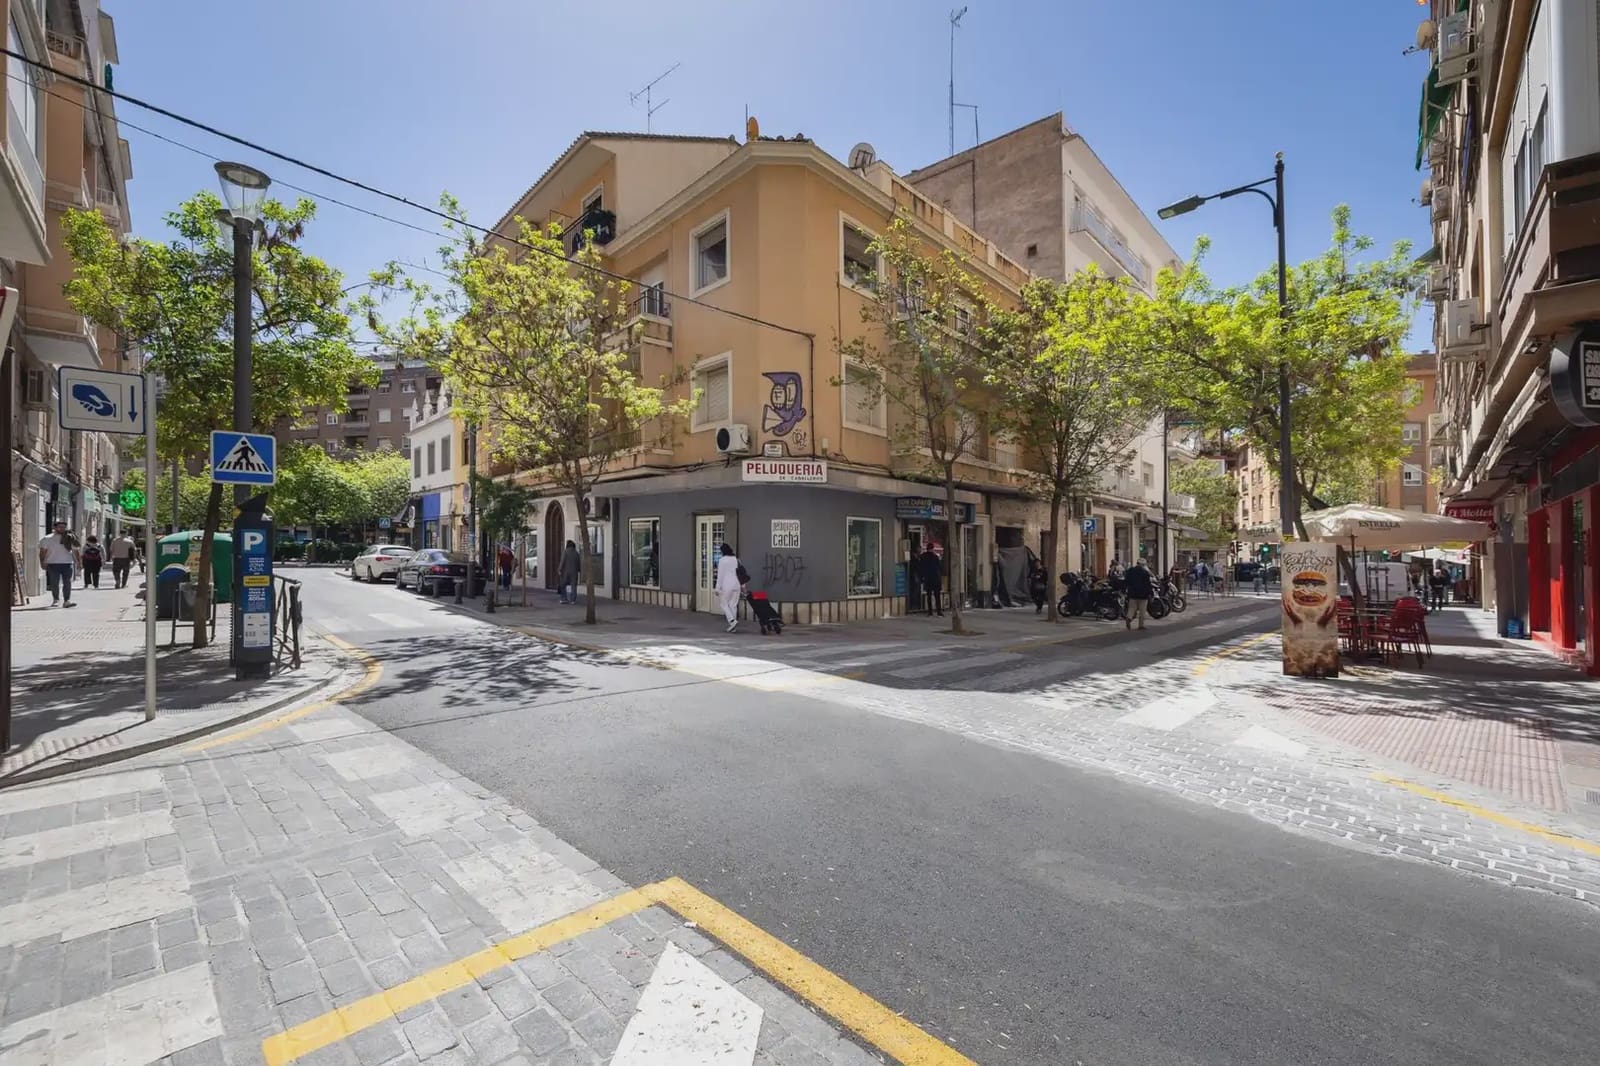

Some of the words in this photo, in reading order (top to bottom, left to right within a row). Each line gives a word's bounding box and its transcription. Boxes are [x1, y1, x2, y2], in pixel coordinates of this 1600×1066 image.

[746, 462, 824, 476] PELUQUERIA
[1083, 519, 1093, 531] P
[1358, 520, 1401, 529] ESTRELLA
[243, 532, 264, 551] P
[772, 531, 799, 547] cachá
